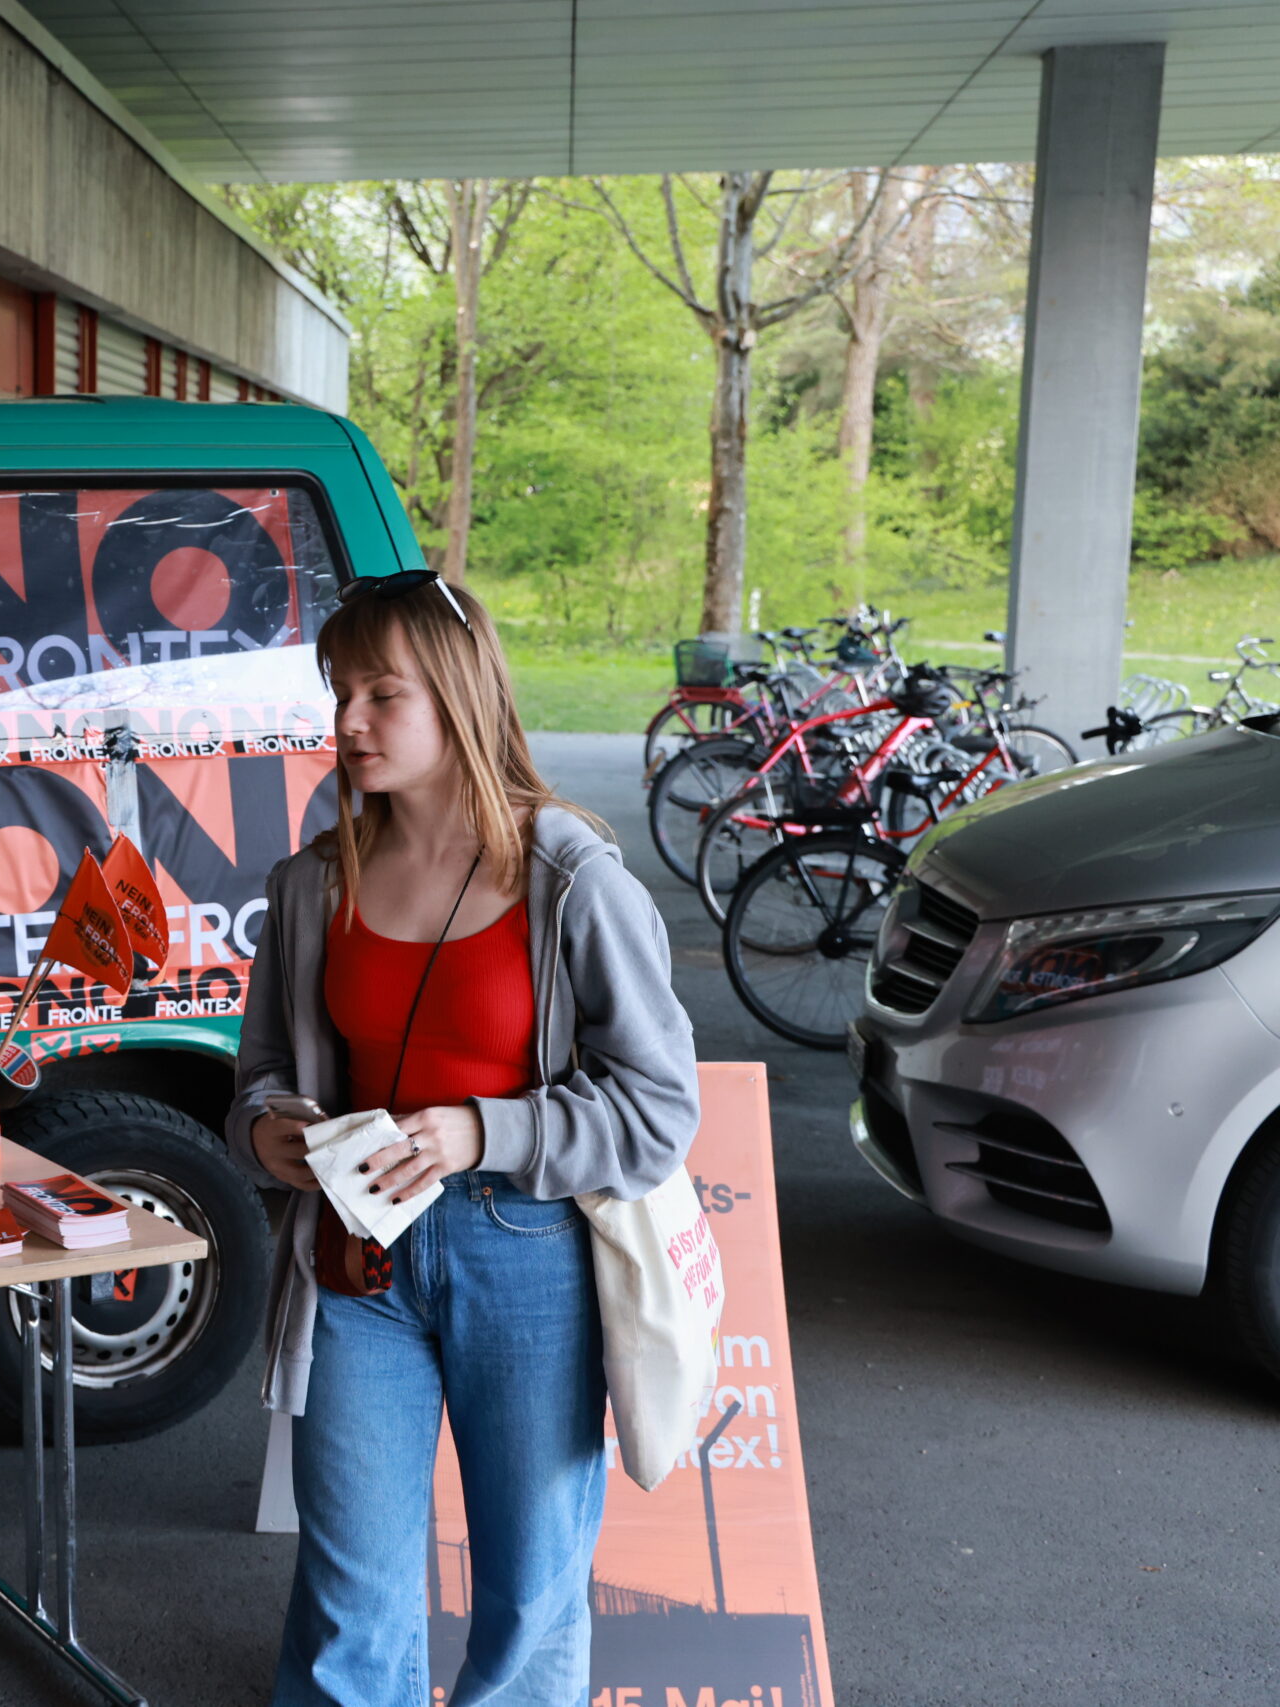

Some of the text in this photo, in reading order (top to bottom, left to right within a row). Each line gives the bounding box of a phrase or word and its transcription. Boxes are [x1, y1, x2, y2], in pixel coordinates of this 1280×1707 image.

[29, 745, 110, 763] FRONTE
[137, 740, 226, 759] FRONTEX
[243, 735, 329, 754] FRONTEX
[116, 880, 154, 916] NEIN!
[48, 1005, 123, 1026] FRONTE
[155, 998, 242, 1018] FRONTEX
